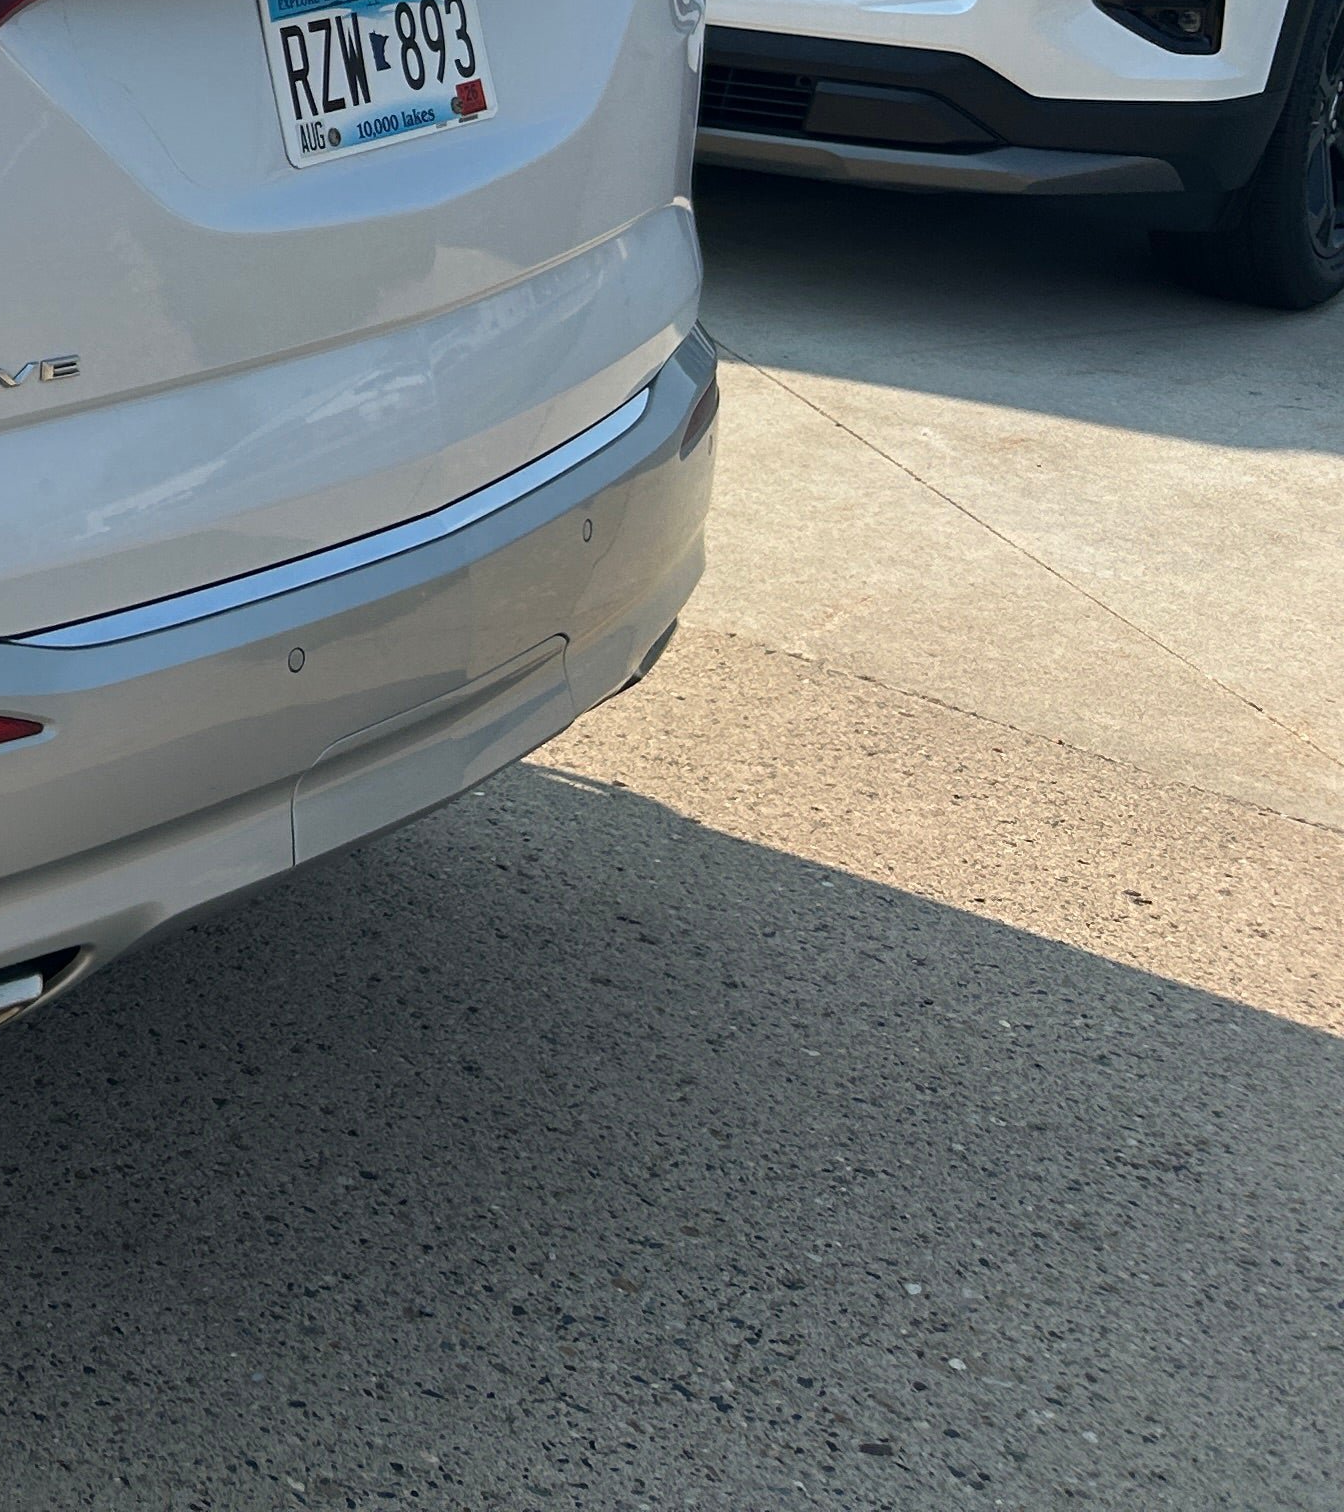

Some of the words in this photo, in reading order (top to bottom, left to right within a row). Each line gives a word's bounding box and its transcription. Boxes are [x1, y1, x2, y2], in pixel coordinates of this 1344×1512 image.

[280, 12, 372, 121] RZW
[299, 121, 326, 154] AUG
[356, 114, 400, 140] 10,000
[402, 107, 436, 129] lakes
